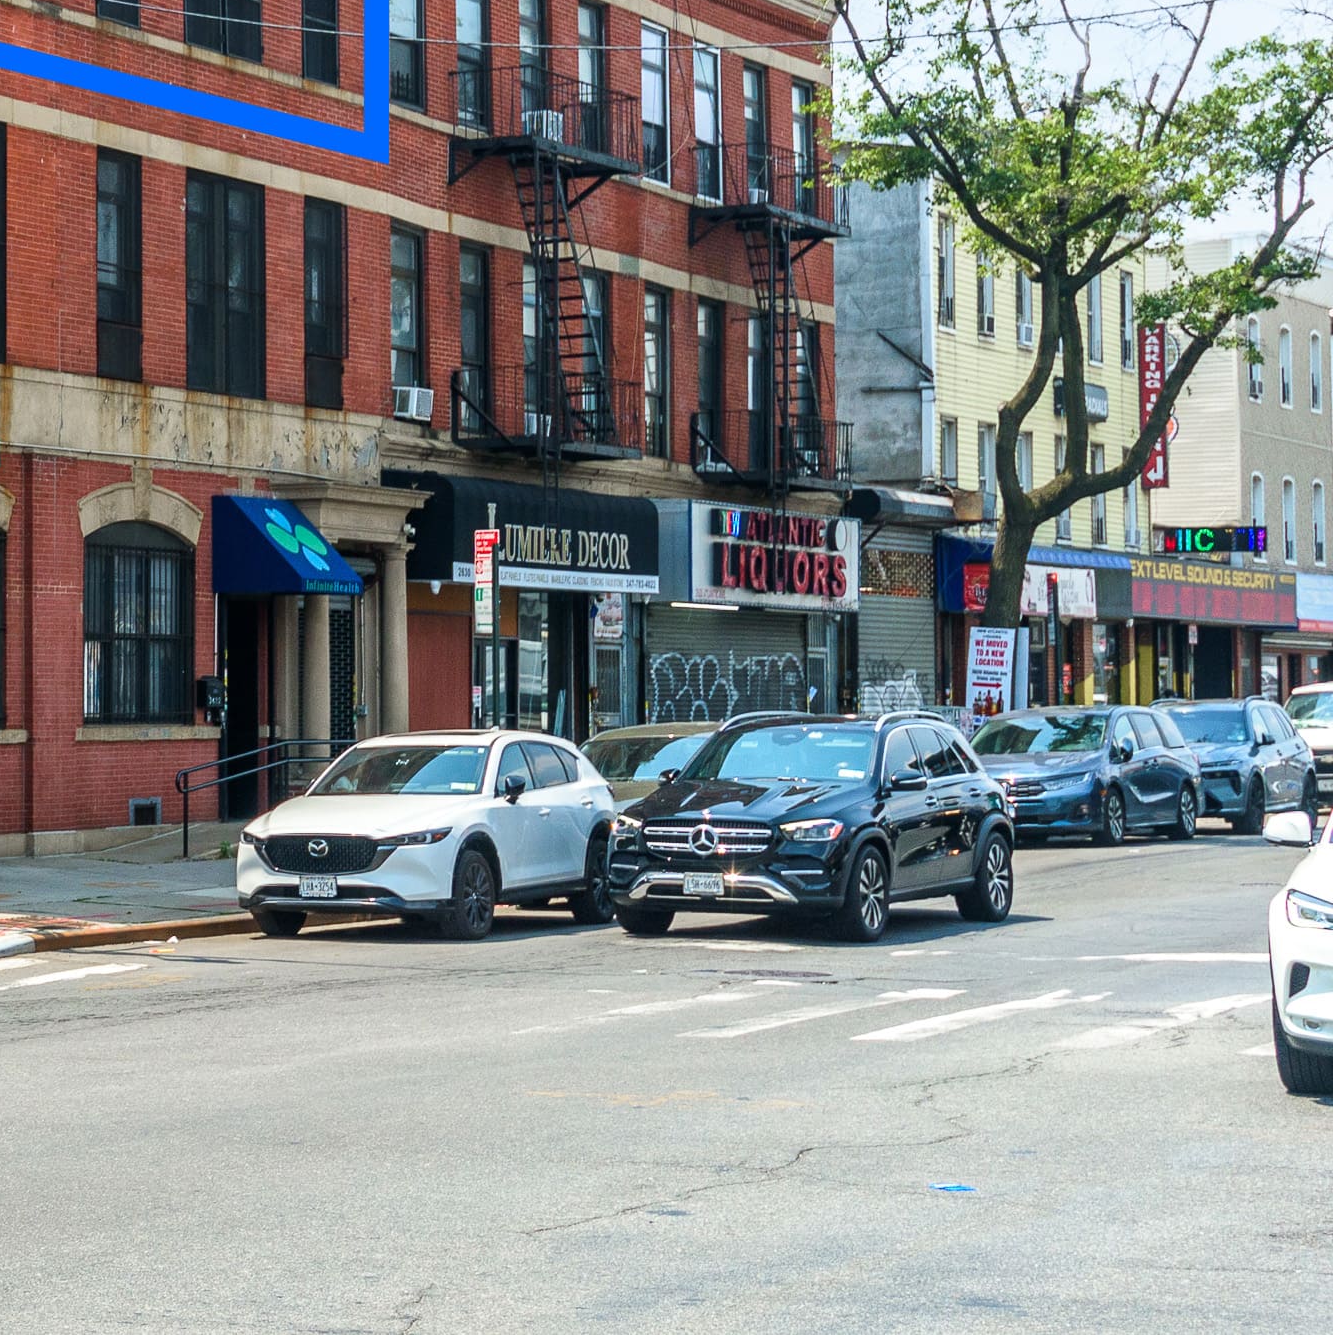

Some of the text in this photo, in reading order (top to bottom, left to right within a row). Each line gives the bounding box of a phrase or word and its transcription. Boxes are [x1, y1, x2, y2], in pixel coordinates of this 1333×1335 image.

[577, 531, 631, 570] DECOR
[721, 543, 847, 598] LIQUORS
[1130, 559, 1152, 578] EXT
[1153, 562, 1185, 581] LEVEL
[1188, 565, 1223, 585] SOUND
[1233, 570, 1276, 590] SECURITY
[975, 639, 1008, 648] WE MOVED
[976, 648, 984, 656] TO
[975, 658, 1004, 667] LOCATION
